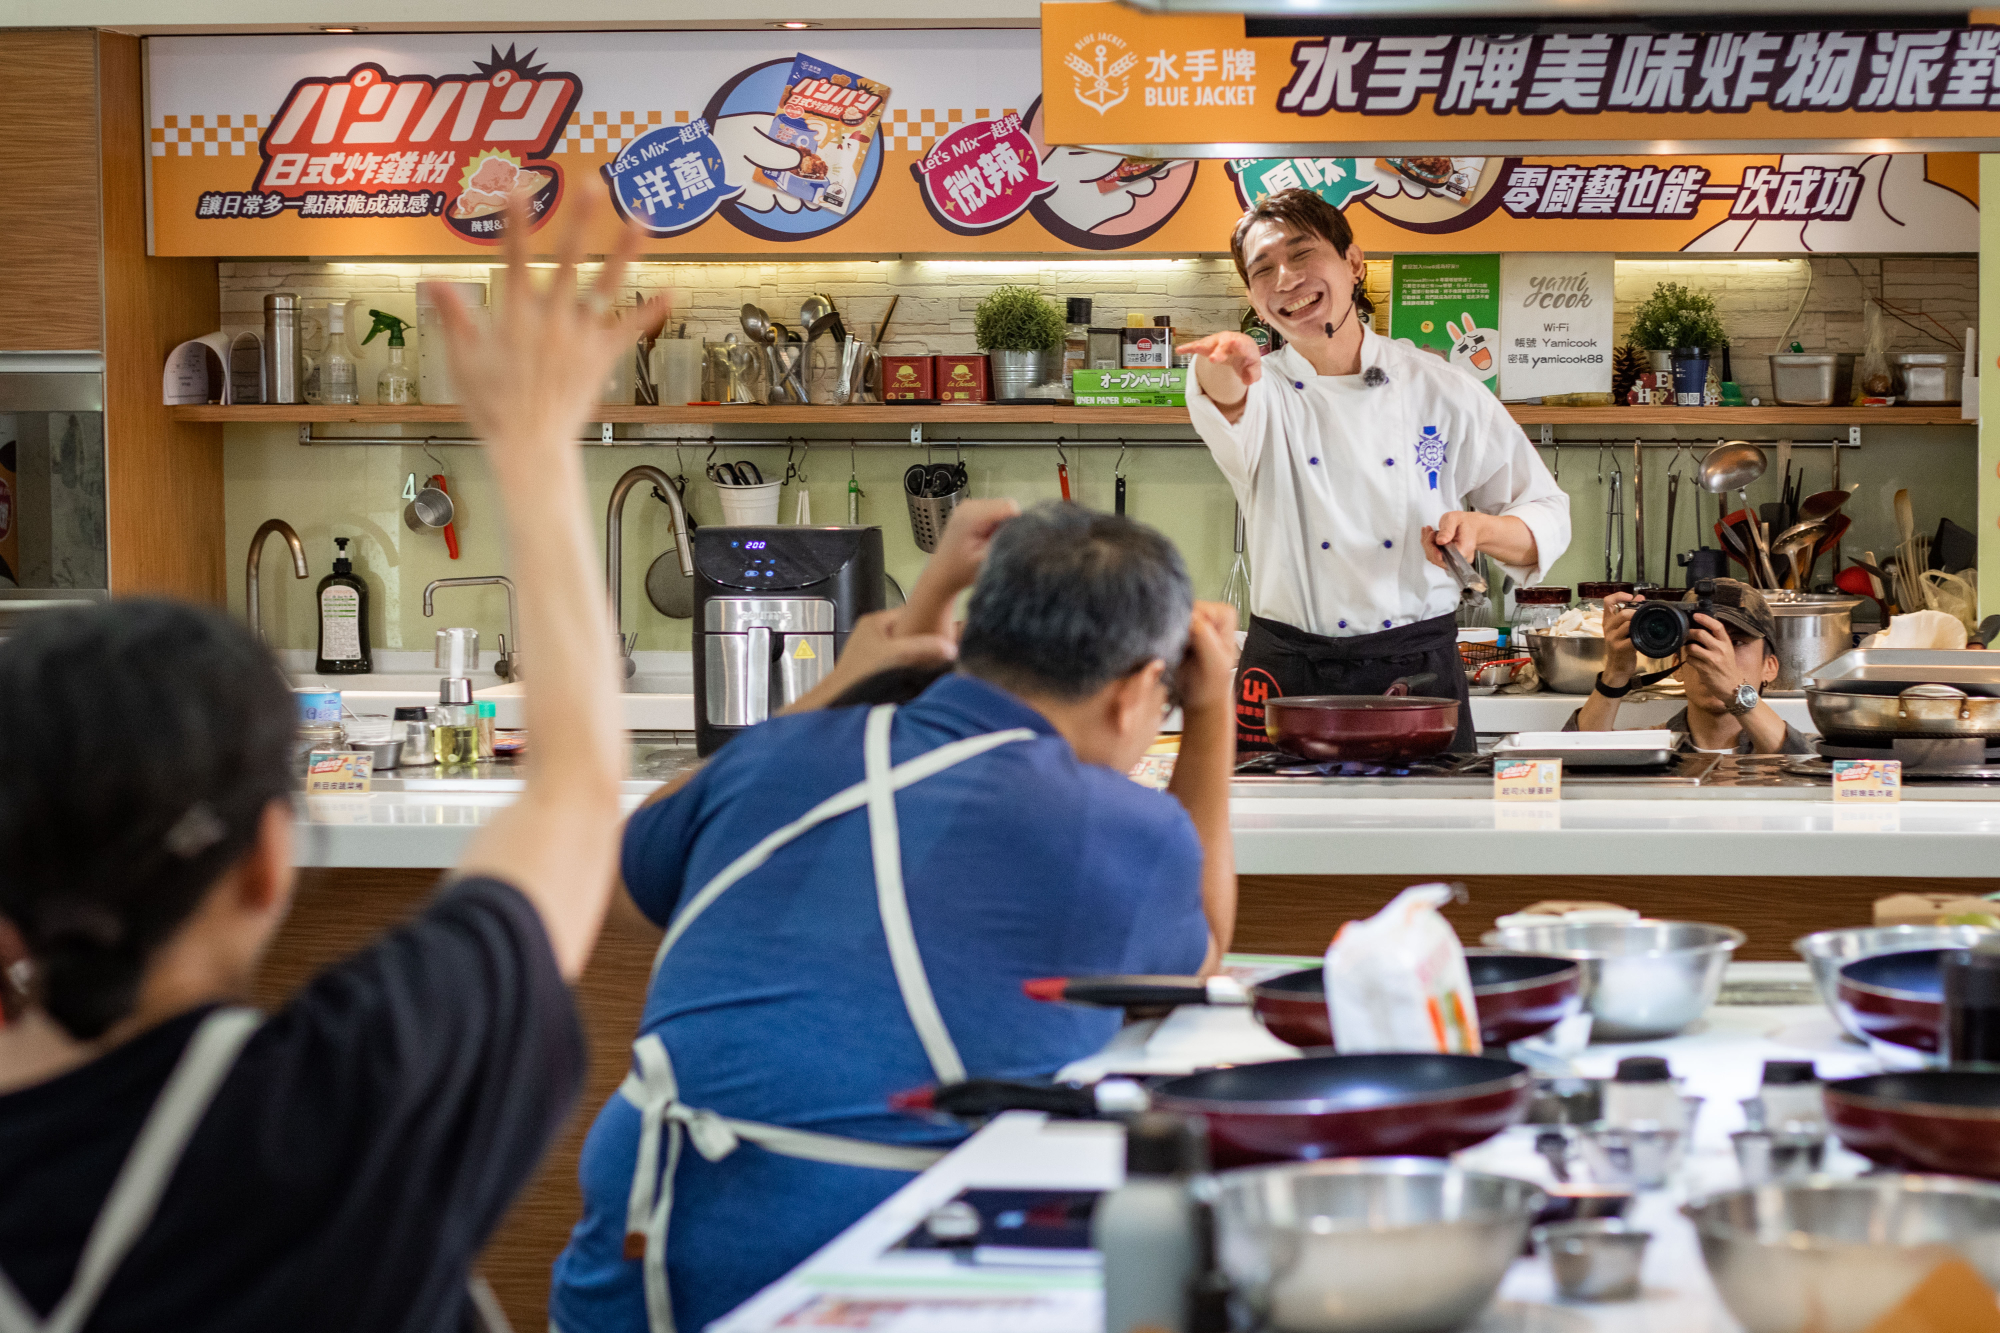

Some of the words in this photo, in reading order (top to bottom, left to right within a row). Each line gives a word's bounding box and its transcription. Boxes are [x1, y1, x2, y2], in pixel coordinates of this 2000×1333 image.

[1075, 33, 1095, 50] BLUE
[1098, 32, 1127, 49] JACKET
[1145, 48, 1257, 83] 水手牌
[270, 69, 567, 145] パンパン
[1145, 86, 1189, 107] BLUE
[1194, 86, 1257, 106] JACKET
[263, 151, 456, 187] 日式炸雞粉
[606, 154, 639, 178] Let's
[916, 151, 951, 175] Let's
[632, 151, 716, 216] 洋蔥
[943, 141, 1029, 217] 微辣
[1502, 167, 1860, 216] 零廚藝也能一次成功
[198, 193, 445, 217] 讓日常多一點酥脆成就感！
[1538, 287, 1593, 309] cook
[1543, 322, 1570, 332] Wi-Fi
[1515, 338, 1537, 348] 帳號
[1542, 338, 1597, 348] Yamicook
[1140, 352, 1163, 363] 참기름
[1507, 354, 1529, 364] 密碼
[1532, 354, 1604, 369] yamicook88
[1100, 371, 1180, 389] オーブンペーパー
[1076, 396, 1095, 404] OVEN
[402, 472, 417, 502] 4
[745, 541, 767, 549] 200
